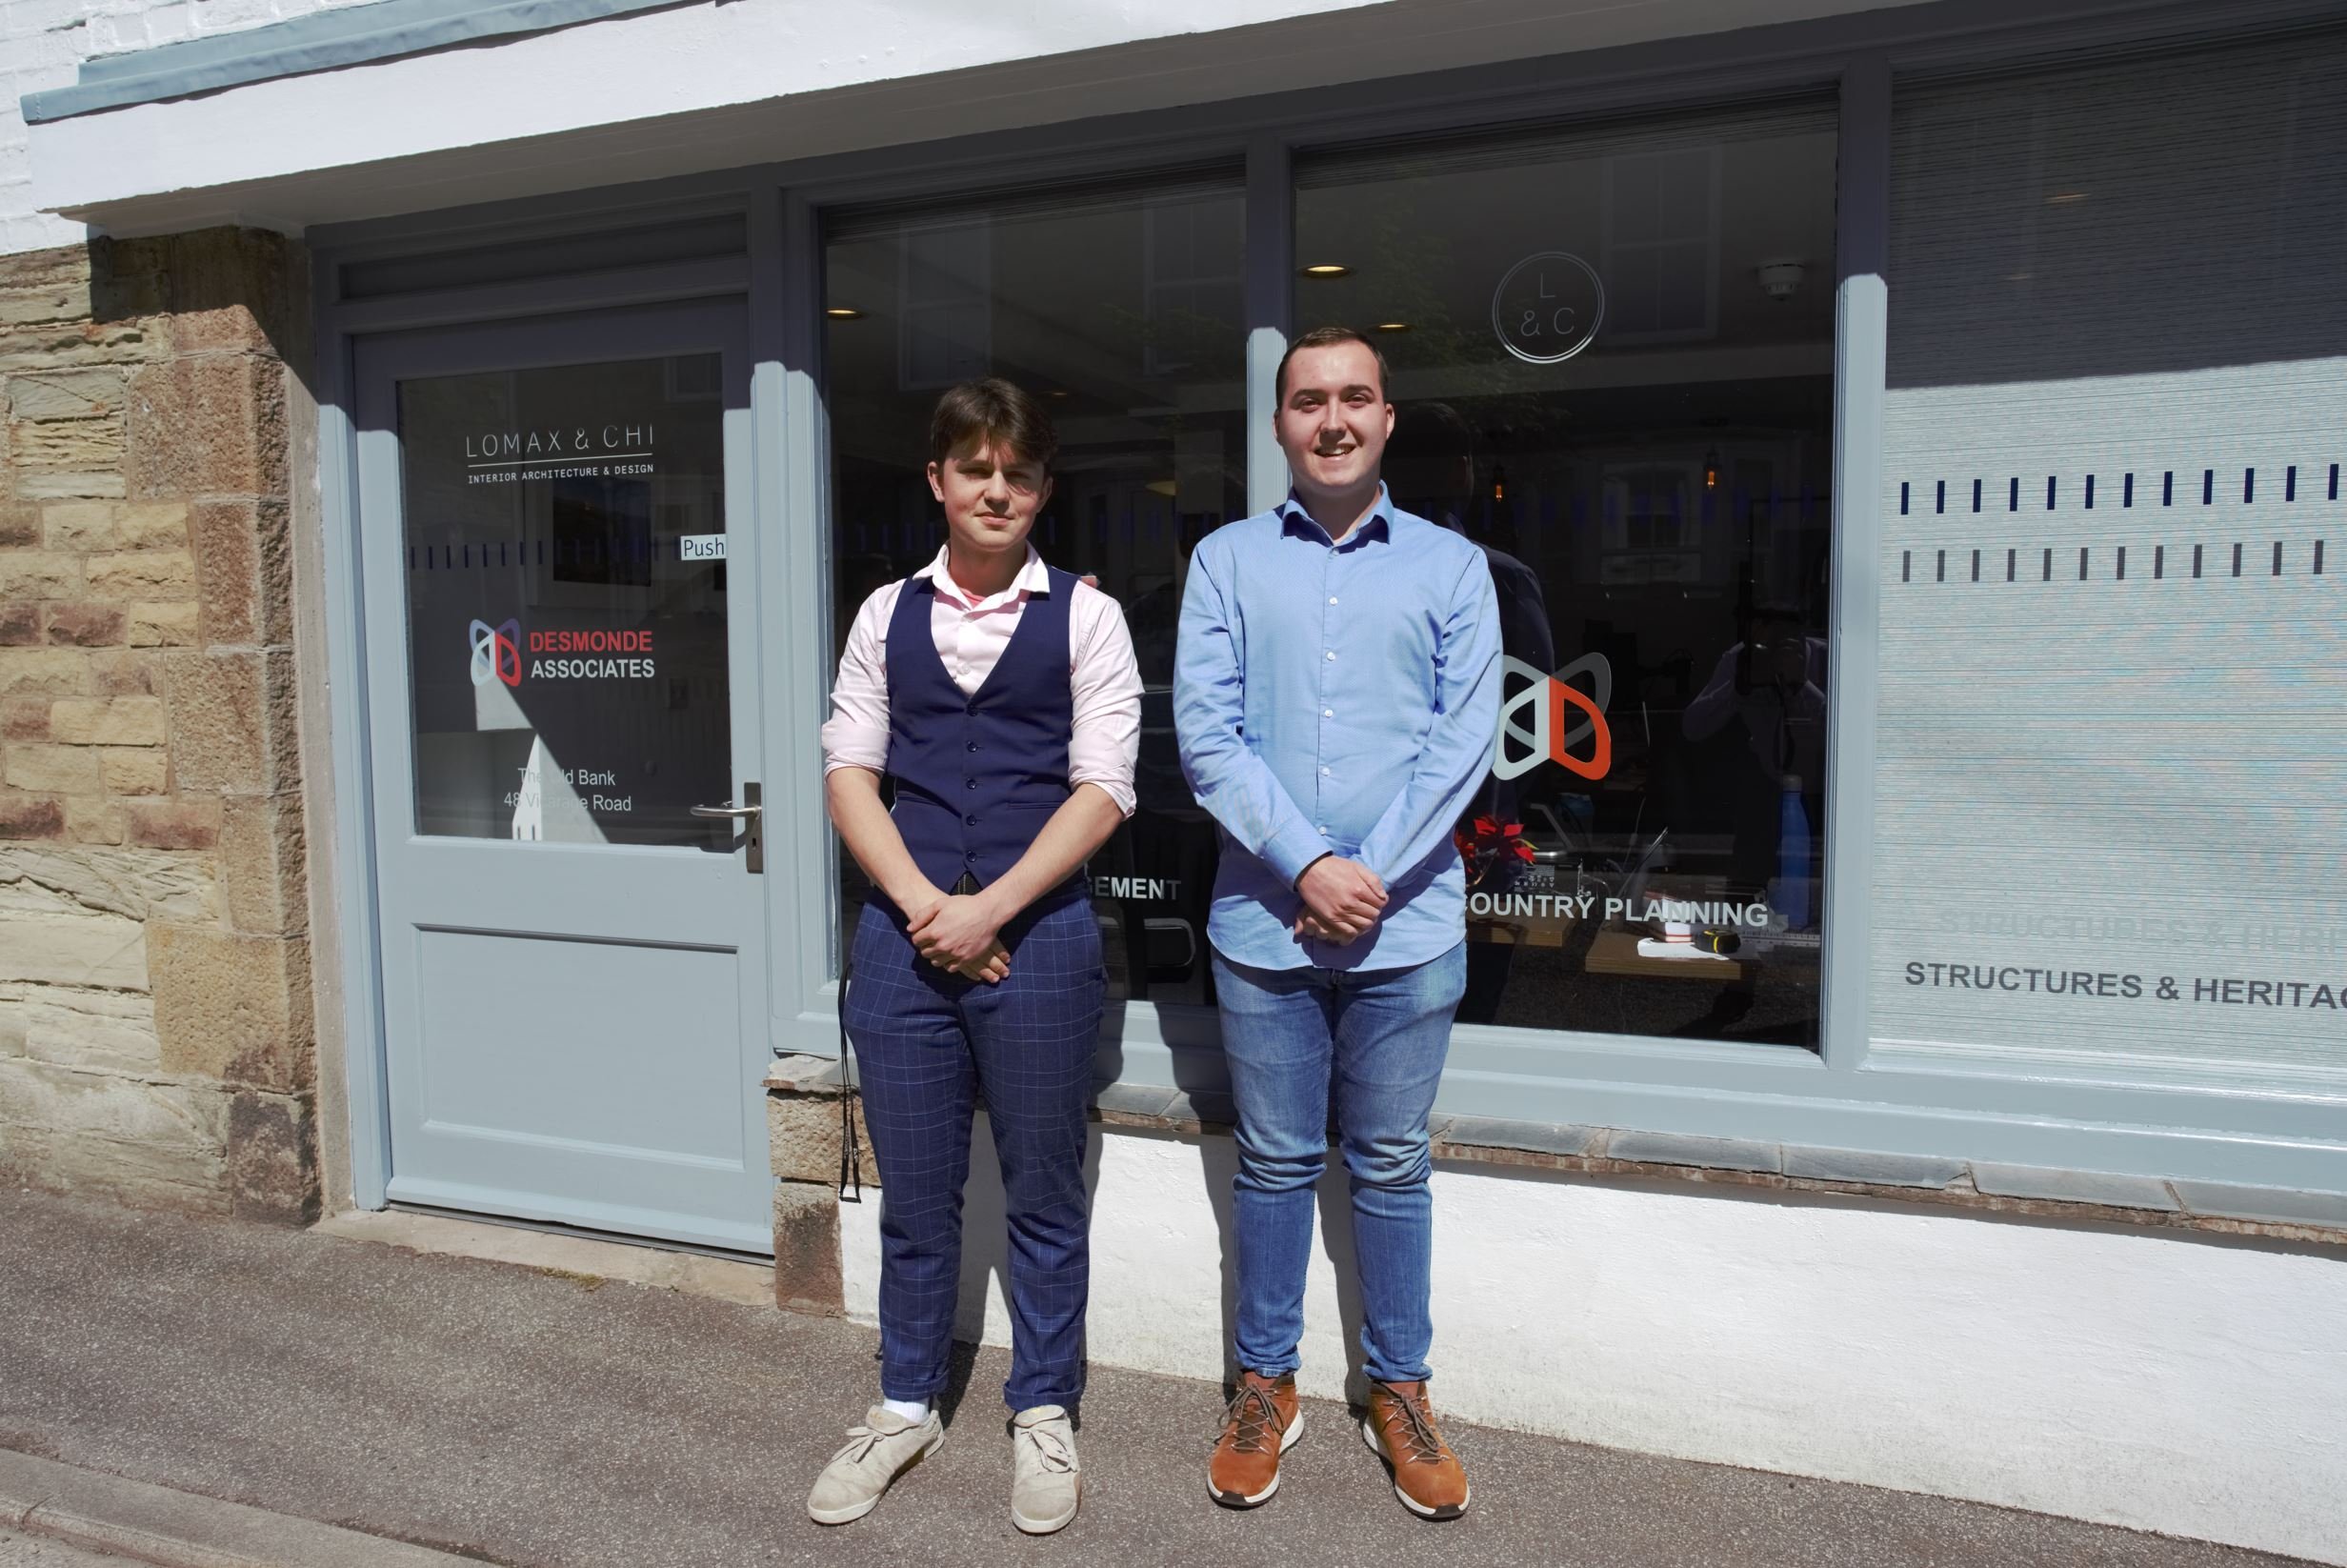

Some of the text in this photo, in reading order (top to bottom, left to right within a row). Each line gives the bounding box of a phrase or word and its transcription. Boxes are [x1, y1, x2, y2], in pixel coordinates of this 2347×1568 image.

[1520, 307, 1575, 336] & C
[466, 423, 653, 457] LOMAX & CHI
[468, 464, 654, 484] INTERIOR ARCHITECTURE & DESIGN
[683, 537, 725, 556] Push
[530, 631, 653, 653] DESMONDE
[531, 659, 655, 679] ASSOCIATES
[578, 769, 616, 786] Bank
[504, 792, 521, 807] 48
[592, 794, 632, 812] Road
[1090, 875, 1181, 900] EMENT
[1465, 892, 1769, 927] OUNTRY PLANNING
[1905, 960, 2143, 998] STRUCTURES
[2155, 975, 2180, 1000] &
